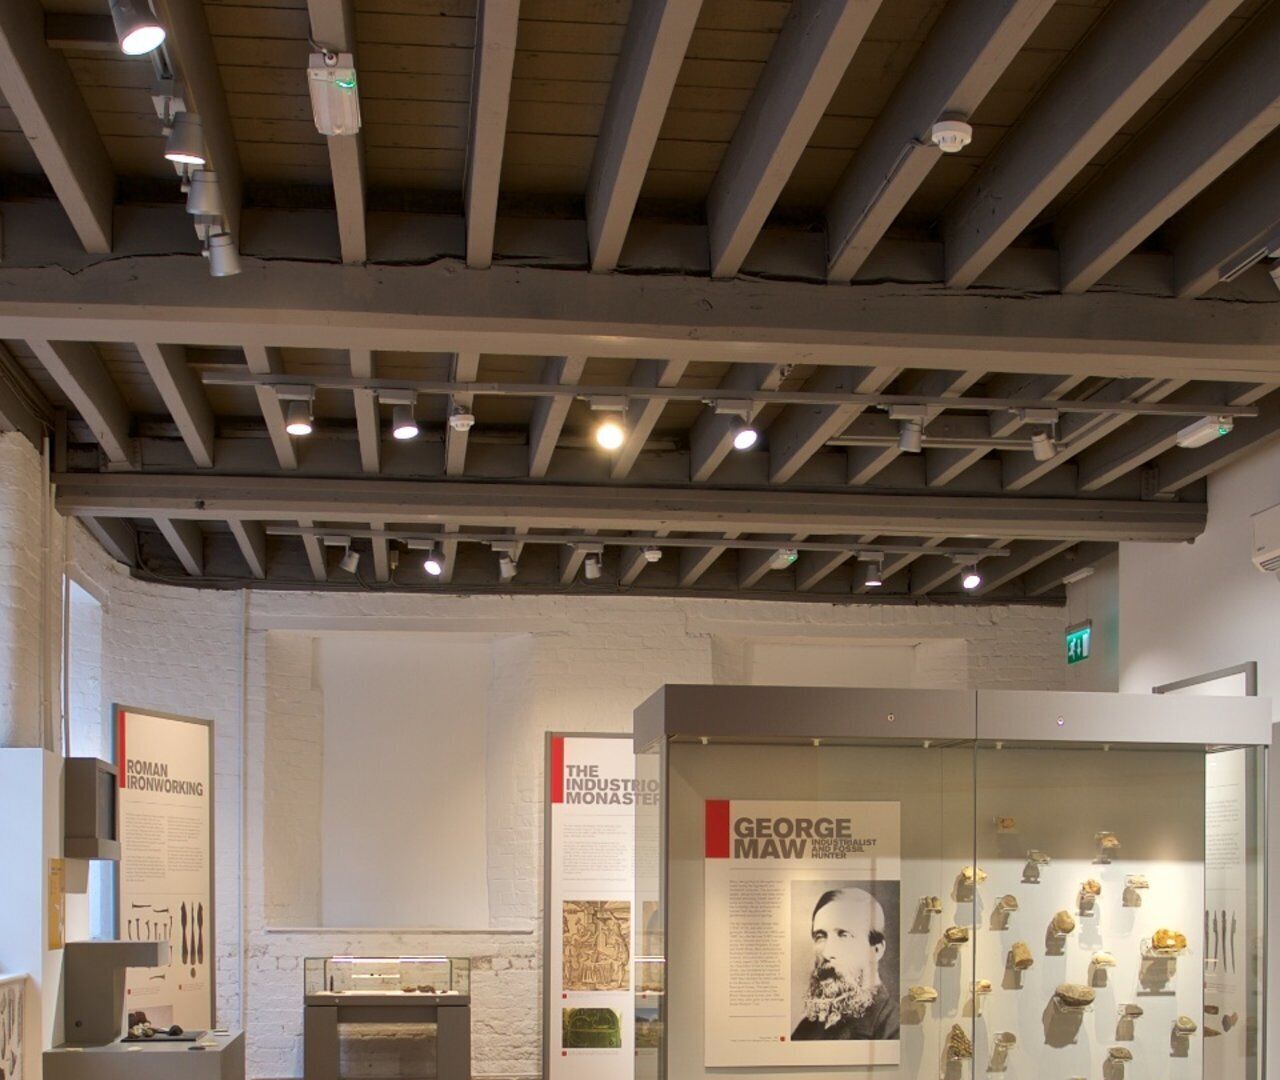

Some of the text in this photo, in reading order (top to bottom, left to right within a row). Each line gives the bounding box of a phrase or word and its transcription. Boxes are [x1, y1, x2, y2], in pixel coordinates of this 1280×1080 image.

[127, 759, 168, 778] ROMAN
[566, 765, 599, 778] THE
[127, 775, 204, 796] IRONWORKING
[566, 779, 659, 792] INDUSTRIO
[734, 817, 852, 839] GEORGE
[734, 838, 877, 859] MAW INDUSTRIALIST
